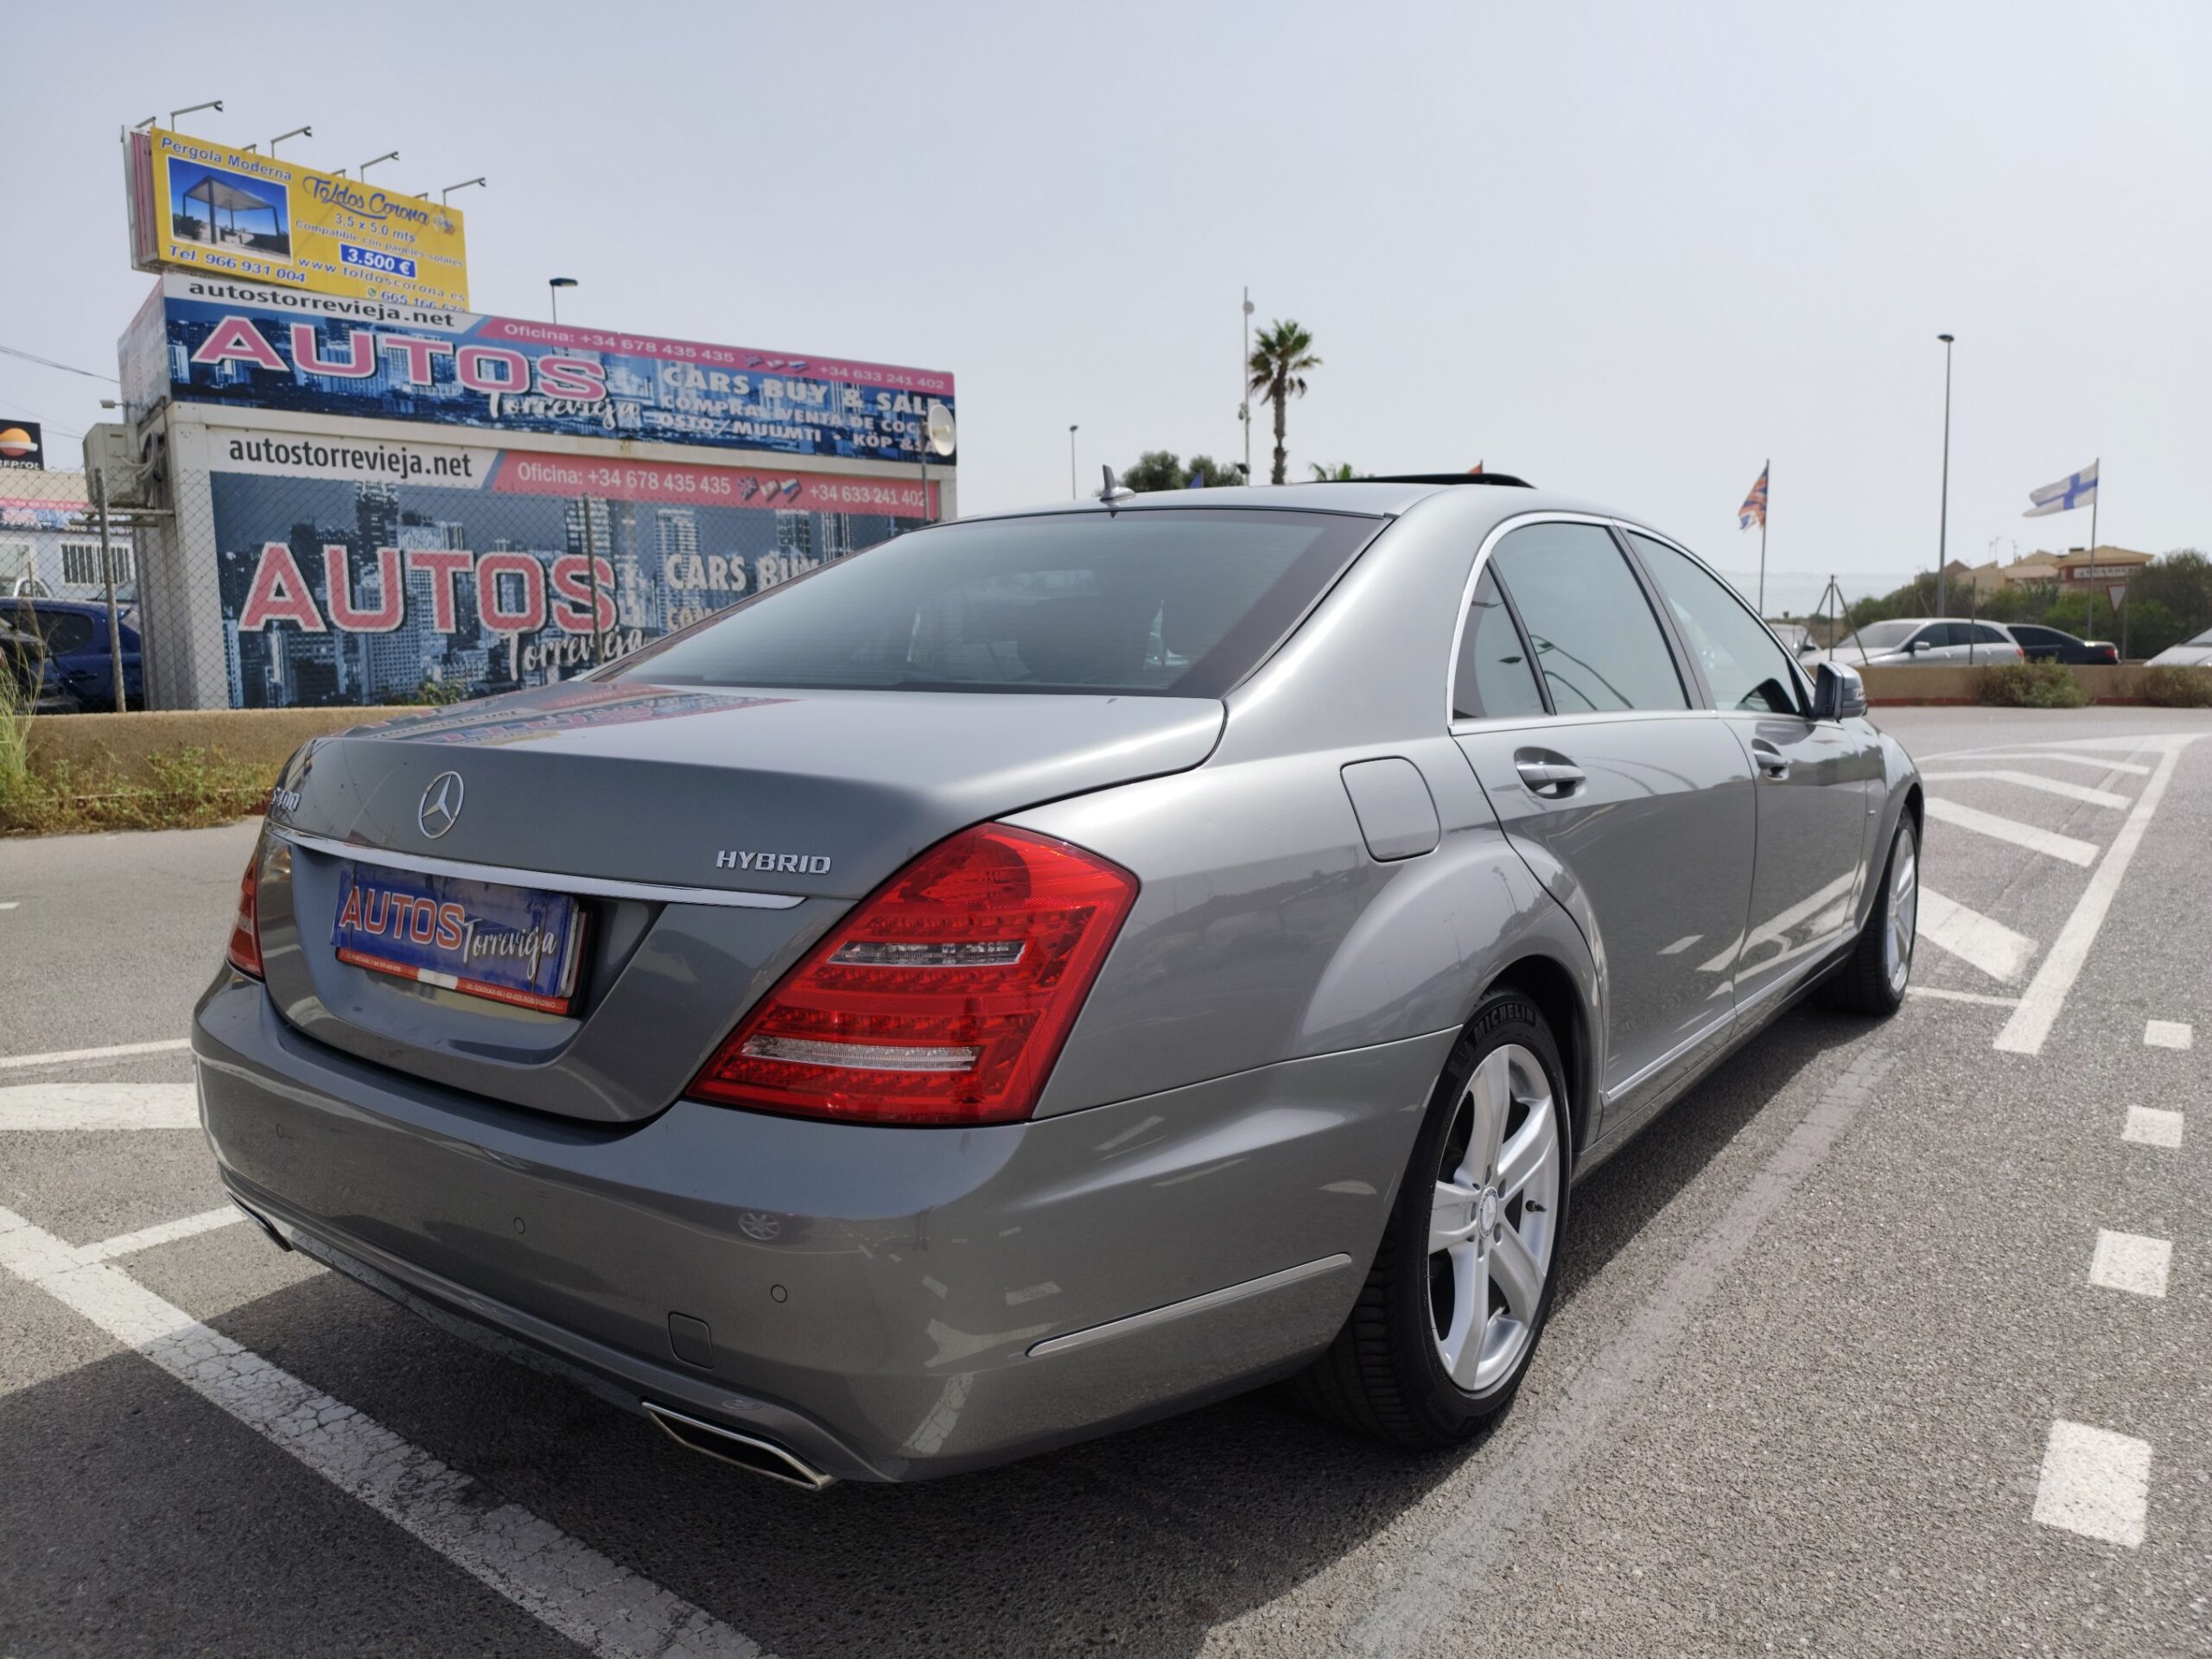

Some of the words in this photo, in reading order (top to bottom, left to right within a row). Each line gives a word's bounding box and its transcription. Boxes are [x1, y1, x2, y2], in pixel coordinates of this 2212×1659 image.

[162, 137, 222, 163] Pérgola
[228, 154, 292, 181] Moderna
[303, 176, 366, 212] Toldos
[369, 193, 430, 226] Corona
[296, 219, 359, 241] Compatible
[363, 236, 382, 248] con
[385, 243, 425, 258] paneles
[429, 251, 463, 266] solares
[393, 229, 416, 243] mts
[206, 253, 238, 269] 966
[241, 260, 270, 276] 931
[276, 268, 306, 283] 004
[347, 248, 395, 271] 3.500
[399, 260, 411, 276] €
[188, 282, 455, 327] autostorrevieja.net
[190, 315, 607, 402] AUTOS
[504, 323, 575, 343] Oficina:
[581, 334, 616, 347] +34
[621, 338, 658, 353] 678
[662, 344, 697, 359] 435
[701, 349, 734, 363] 435
[663, 366, 750, 396] CARS
[763, 378, 830, 404] BUY
[842, 389, 863, 409] &
[820, 366, 849, 377] +34
[853, 369, 882, 382] 633
[887, 373, 913, 386] 241
[918, 378, 944, 390] 402
[850, 416, 874, 430] DE
[853, 431, 893, 448] KÖP
[229, 439, 473, 479] autostorrevieja.net
[518, 462, 582, 485] Oficina:
[588, 468, 621, 487] +34
[626, 470, 659, 489] 678
[664, 474, 696, 493] 435
[700, 476, 731, 494] 435
[810, 484, 838, 501] +34
[842, 486, 870, 502] 633
[874, 487, 898, 505] 241
[901, 490, 929, 507] 402
[238, 542, 617, 634] AUTOS
[666, 553, 746, 592] CARS
[667, 607, 722, 631] COM
[500, 627, 645, 682] Torreveja
[716, 850, 831, 874] HYBRID
[338, 885, 467, 950] AUTOS
[462, 918, 558, 981] Torrevieja
[1473, 1003, 1535, 1044] MICHELIN
